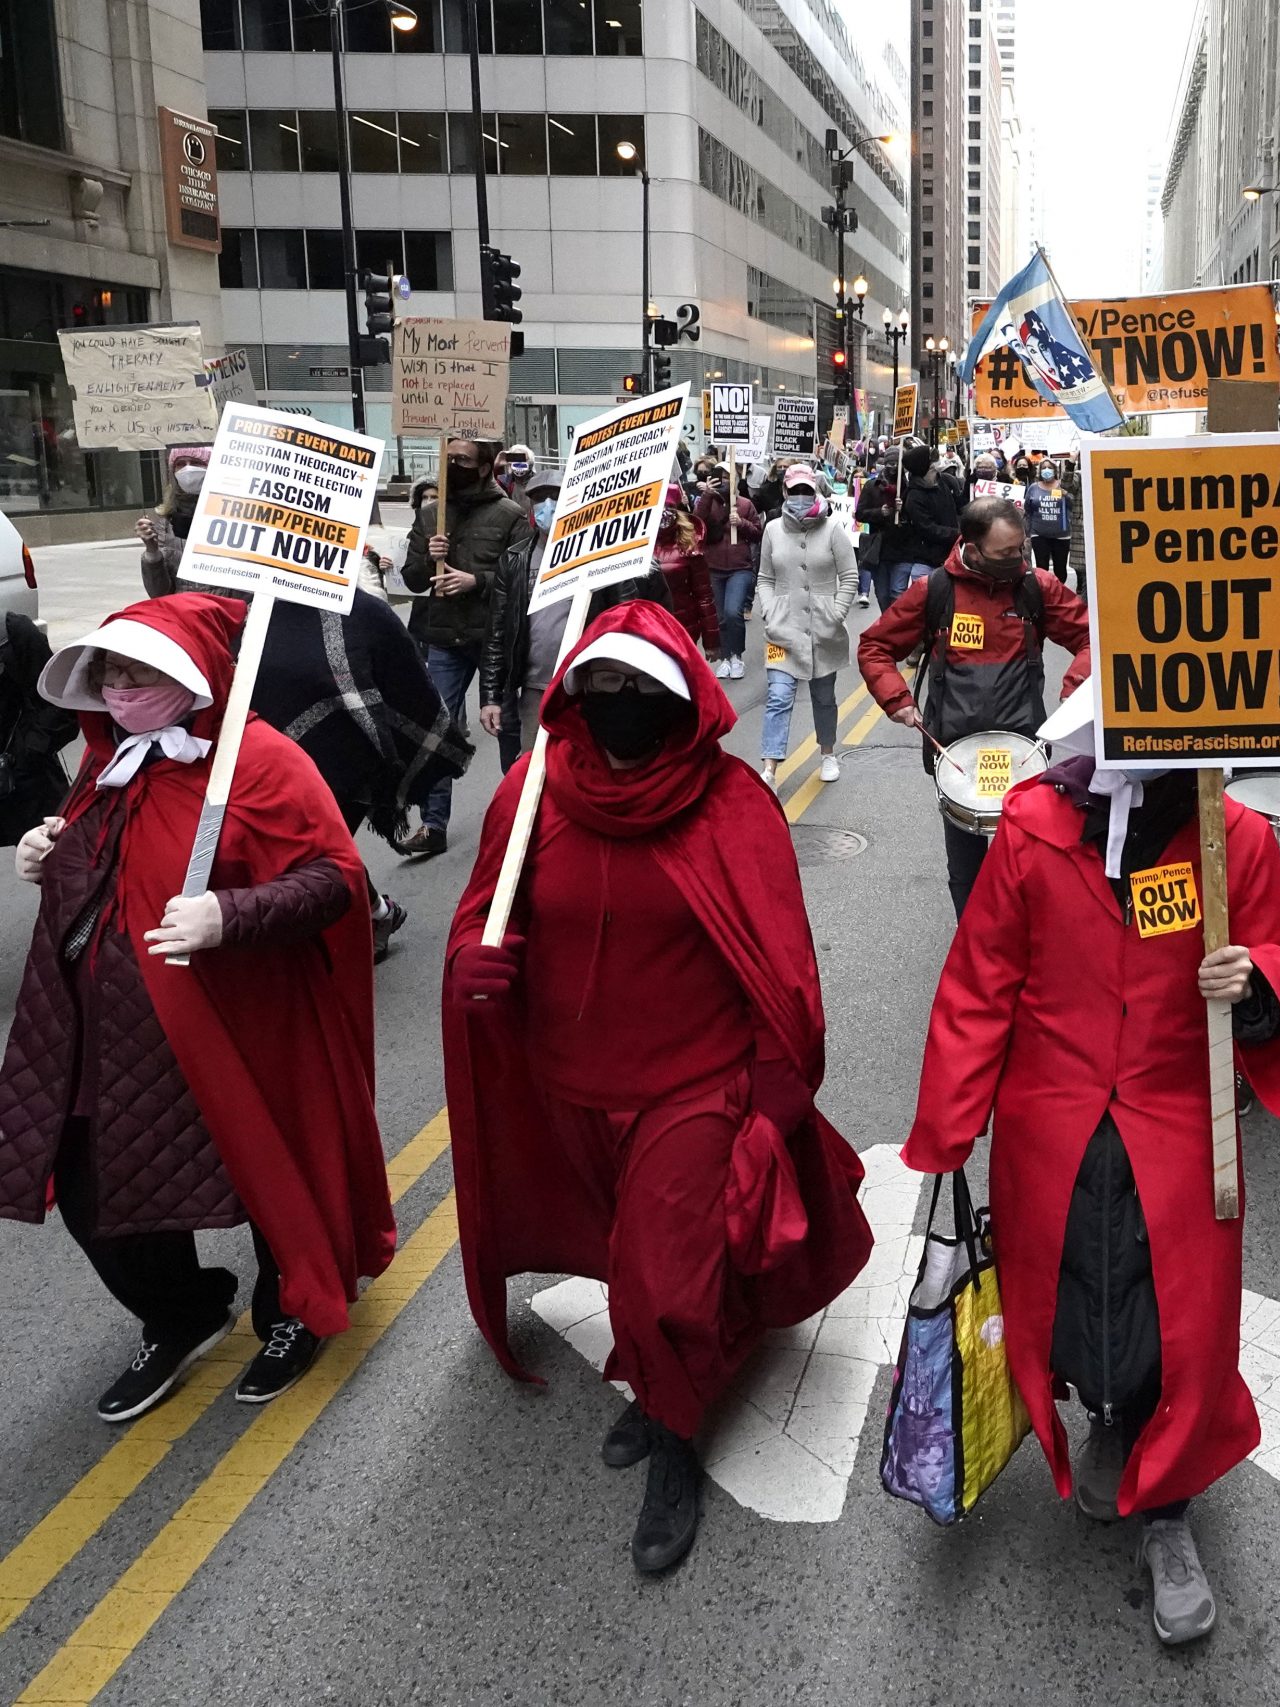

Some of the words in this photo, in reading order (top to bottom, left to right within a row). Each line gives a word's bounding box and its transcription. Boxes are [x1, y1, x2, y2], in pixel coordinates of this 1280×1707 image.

[181, 165, 211, 181] CHICAGO
[676, 303, 701, 342] 2
[88, 338, 115, 348] COULD
[121, 337, 144, 348] HAVE
[402, 327, 421, 354] My
[427, 333, 459, 351] Most
[463, 330, 510, 353] fervent
[108, 353, 163, 370] THERAPY
[450, 361, 476, 373] that
[482, 362, 499, 377] I
[987, 324, 1266, 391] #TNOW!
[87, 381, 185, 395] ENLIGHTENMENT
[402, 377, 420, 389] not
[422, 378, 433, 390] be
[438, 381, 475, 393] replaced
[1147, 387, 1208, 401] @Refuse
[402, 392, 429, 404] until
[434, 396, 444, 406] a
[454, 392, 489, 408] NEW
[714, 387, 749, 413] NO!
[778, 404, 815, 413] OUTNOW
[127, 420, 145, 434] US
[449, 412, 496, 430] Installed
[579, 424, 618, 449] PROTEST
[619, 411, 650, 431] EVERY
[653, 402, 678, 421] DAY!
[775, 428, 805, 437] MURDER
[229, 440, 291, 461] CHRISTIAN
[234, 419, 294, 442] PROTEST
[296, 433, 337, 455] EVERY
[339, 446, 370, 465] DAY!
[775, 436, 798, 444] BLACK
[775, 443, 800, 451] PEOPLE
[567, 462, 612, 488] DESTROYING
[614, 455, 628, 467] THE
[629, 441, 669, 462] ELECTION
[574, 442, 613, 471] CHRISTIAN
[220, 455, 290, 477] DESTROYING
[294, 469, 312, 483] THE
[314, 474, 362, 498] ELECTION
[581, 466, 642, 503] FASCISM
[249, 478, 331, 513] FASCISM
[221, 500, 346, 544] TRUMP/PENCE
[560, 488, 652, 536] TRUMP/PENCE
[206, 519, 266, 551] OUT
[271, 531, 350, 574] NOW!
[549, 528, 590, 569] OUT
[590, 509, 653, 551] NOW!
[1120, 520, 1279, 564] Pence
[272, 576, 343, 601] RefuseFascism.org
[1137, 578, 1272, 644] OUT
[953, 632, 982, 645] NOW
[957, 622, 981, 634] OUT
[980, 762, 1010, 770] NOW
[982, 754, 1008, 762] OUT
[1131, 867, 1191, 886] Trump/Pence
[1139, 879, 1188, 907] OUT
[1138, 898, 1196, 930] NOW
